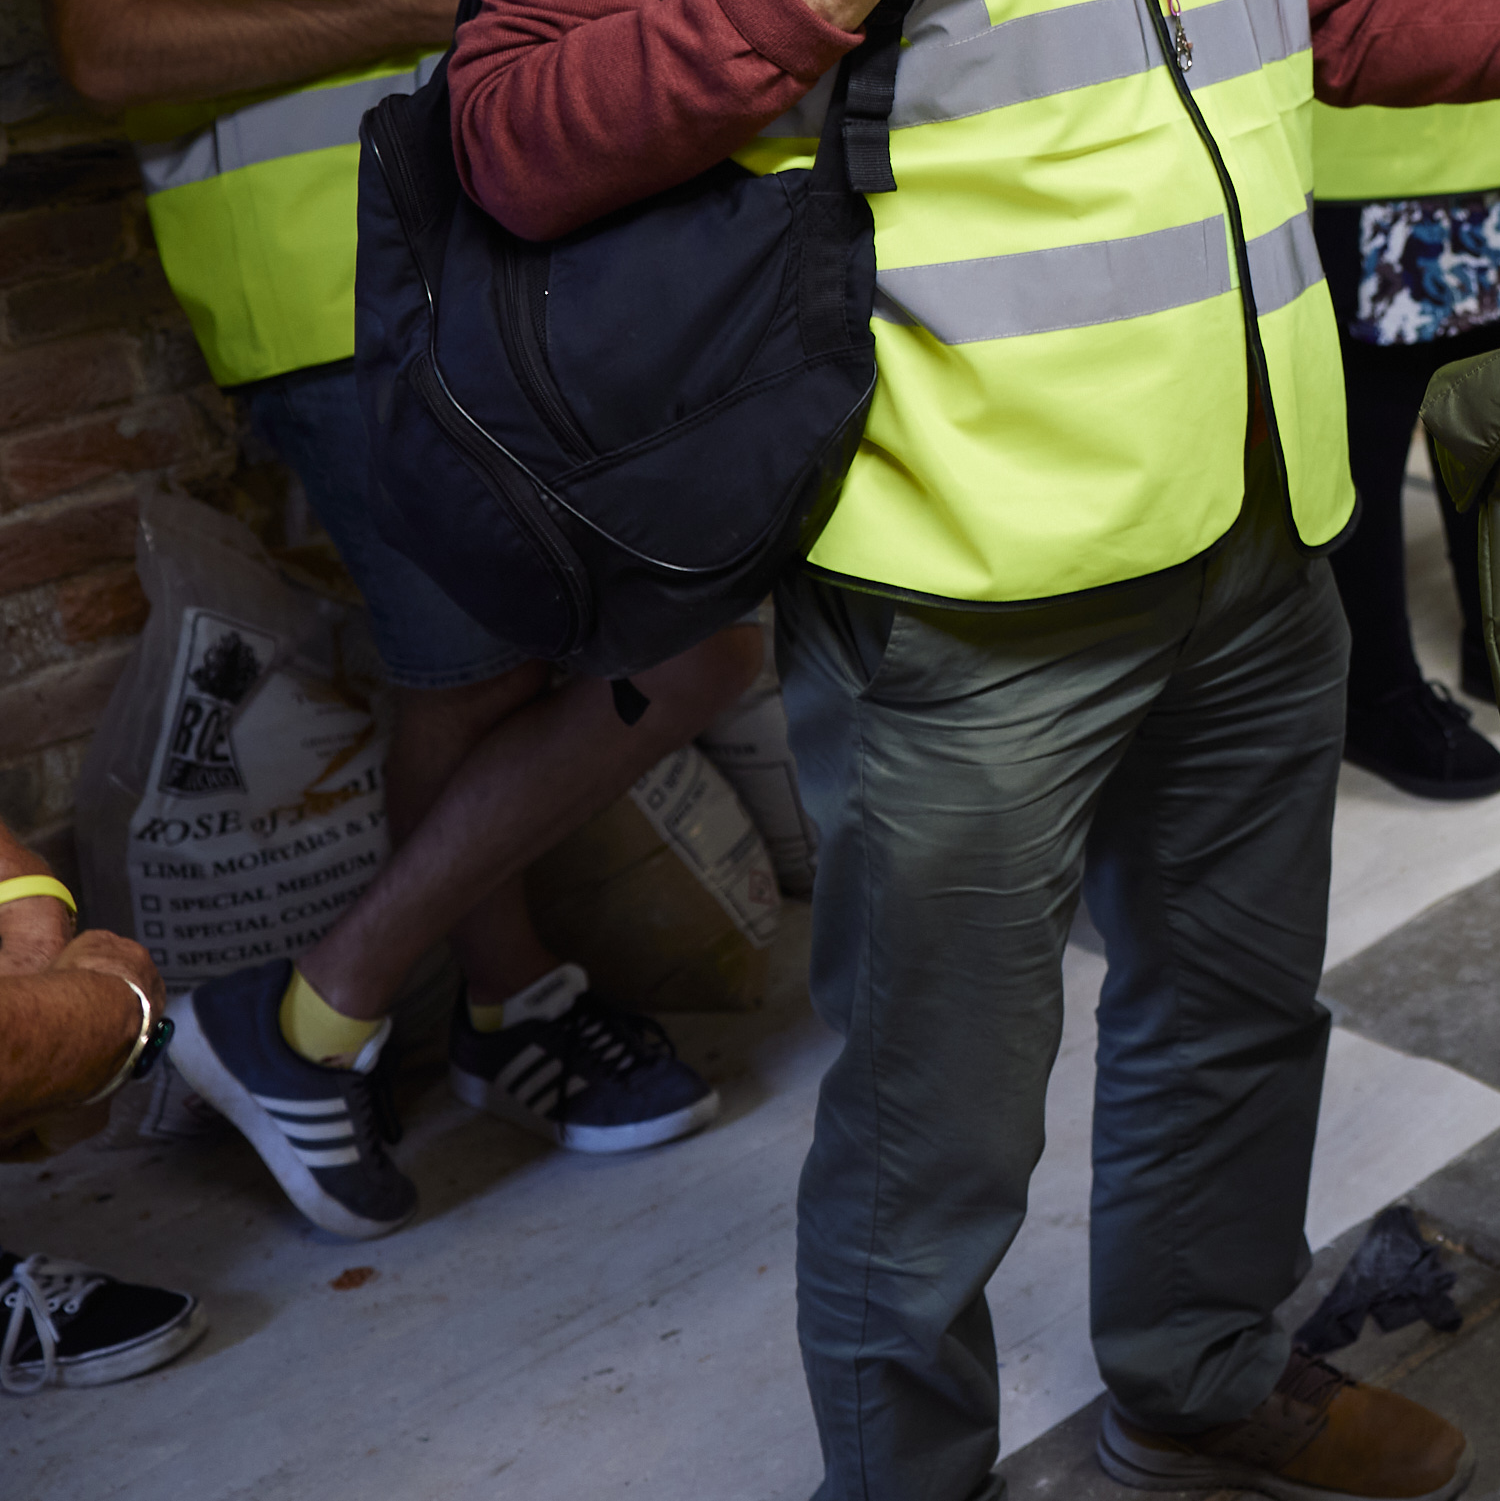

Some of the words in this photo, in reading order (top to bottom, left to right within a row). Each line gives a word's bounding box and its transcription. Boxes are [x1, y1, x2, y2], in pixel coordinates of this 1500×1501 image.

[136, 811, 241, 844] ROSE
[251, 810, 279, 838] of
[143, 862, 206, 880] LIME
[212, 825, 340, 878] MORTARS
[170, 886, 271, 912] SPECIAL
[277, 850, 377, 895] MEDIUM
[173, 916, 276, 940] SPECIAL
[176, 942, 279, 966] SPECIAL
